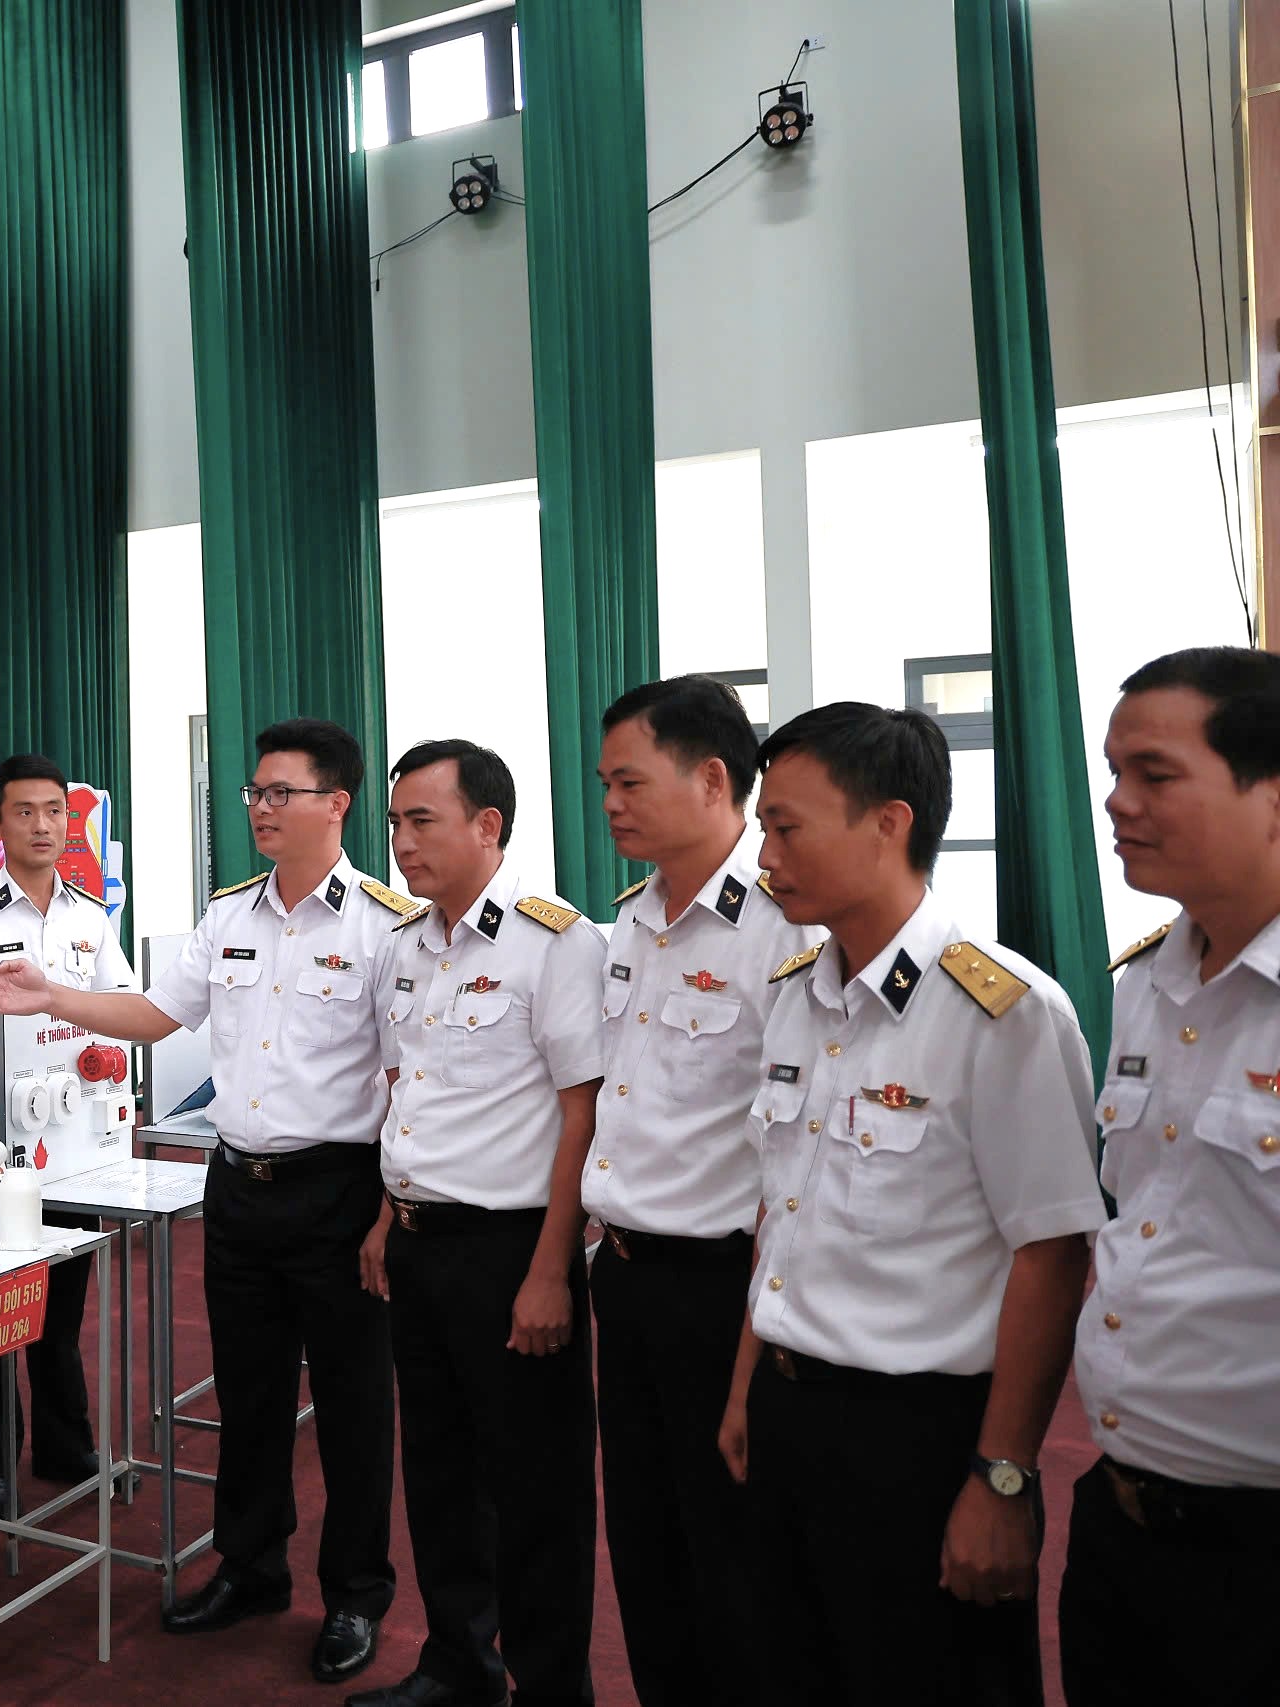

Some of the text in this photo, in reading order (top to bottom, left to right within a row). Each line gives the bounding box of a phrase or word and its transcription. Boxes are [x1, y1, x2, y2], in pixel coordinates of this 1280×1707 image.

[37, 1029, 46, 1046] HỆ
[48, 1024, 71, 1042] THỐNG
[4, 1284, 21, 1315] ĐỘI
[23, 1280, 42, 1306] 515
[11, 1317, 30, 1343] 264
